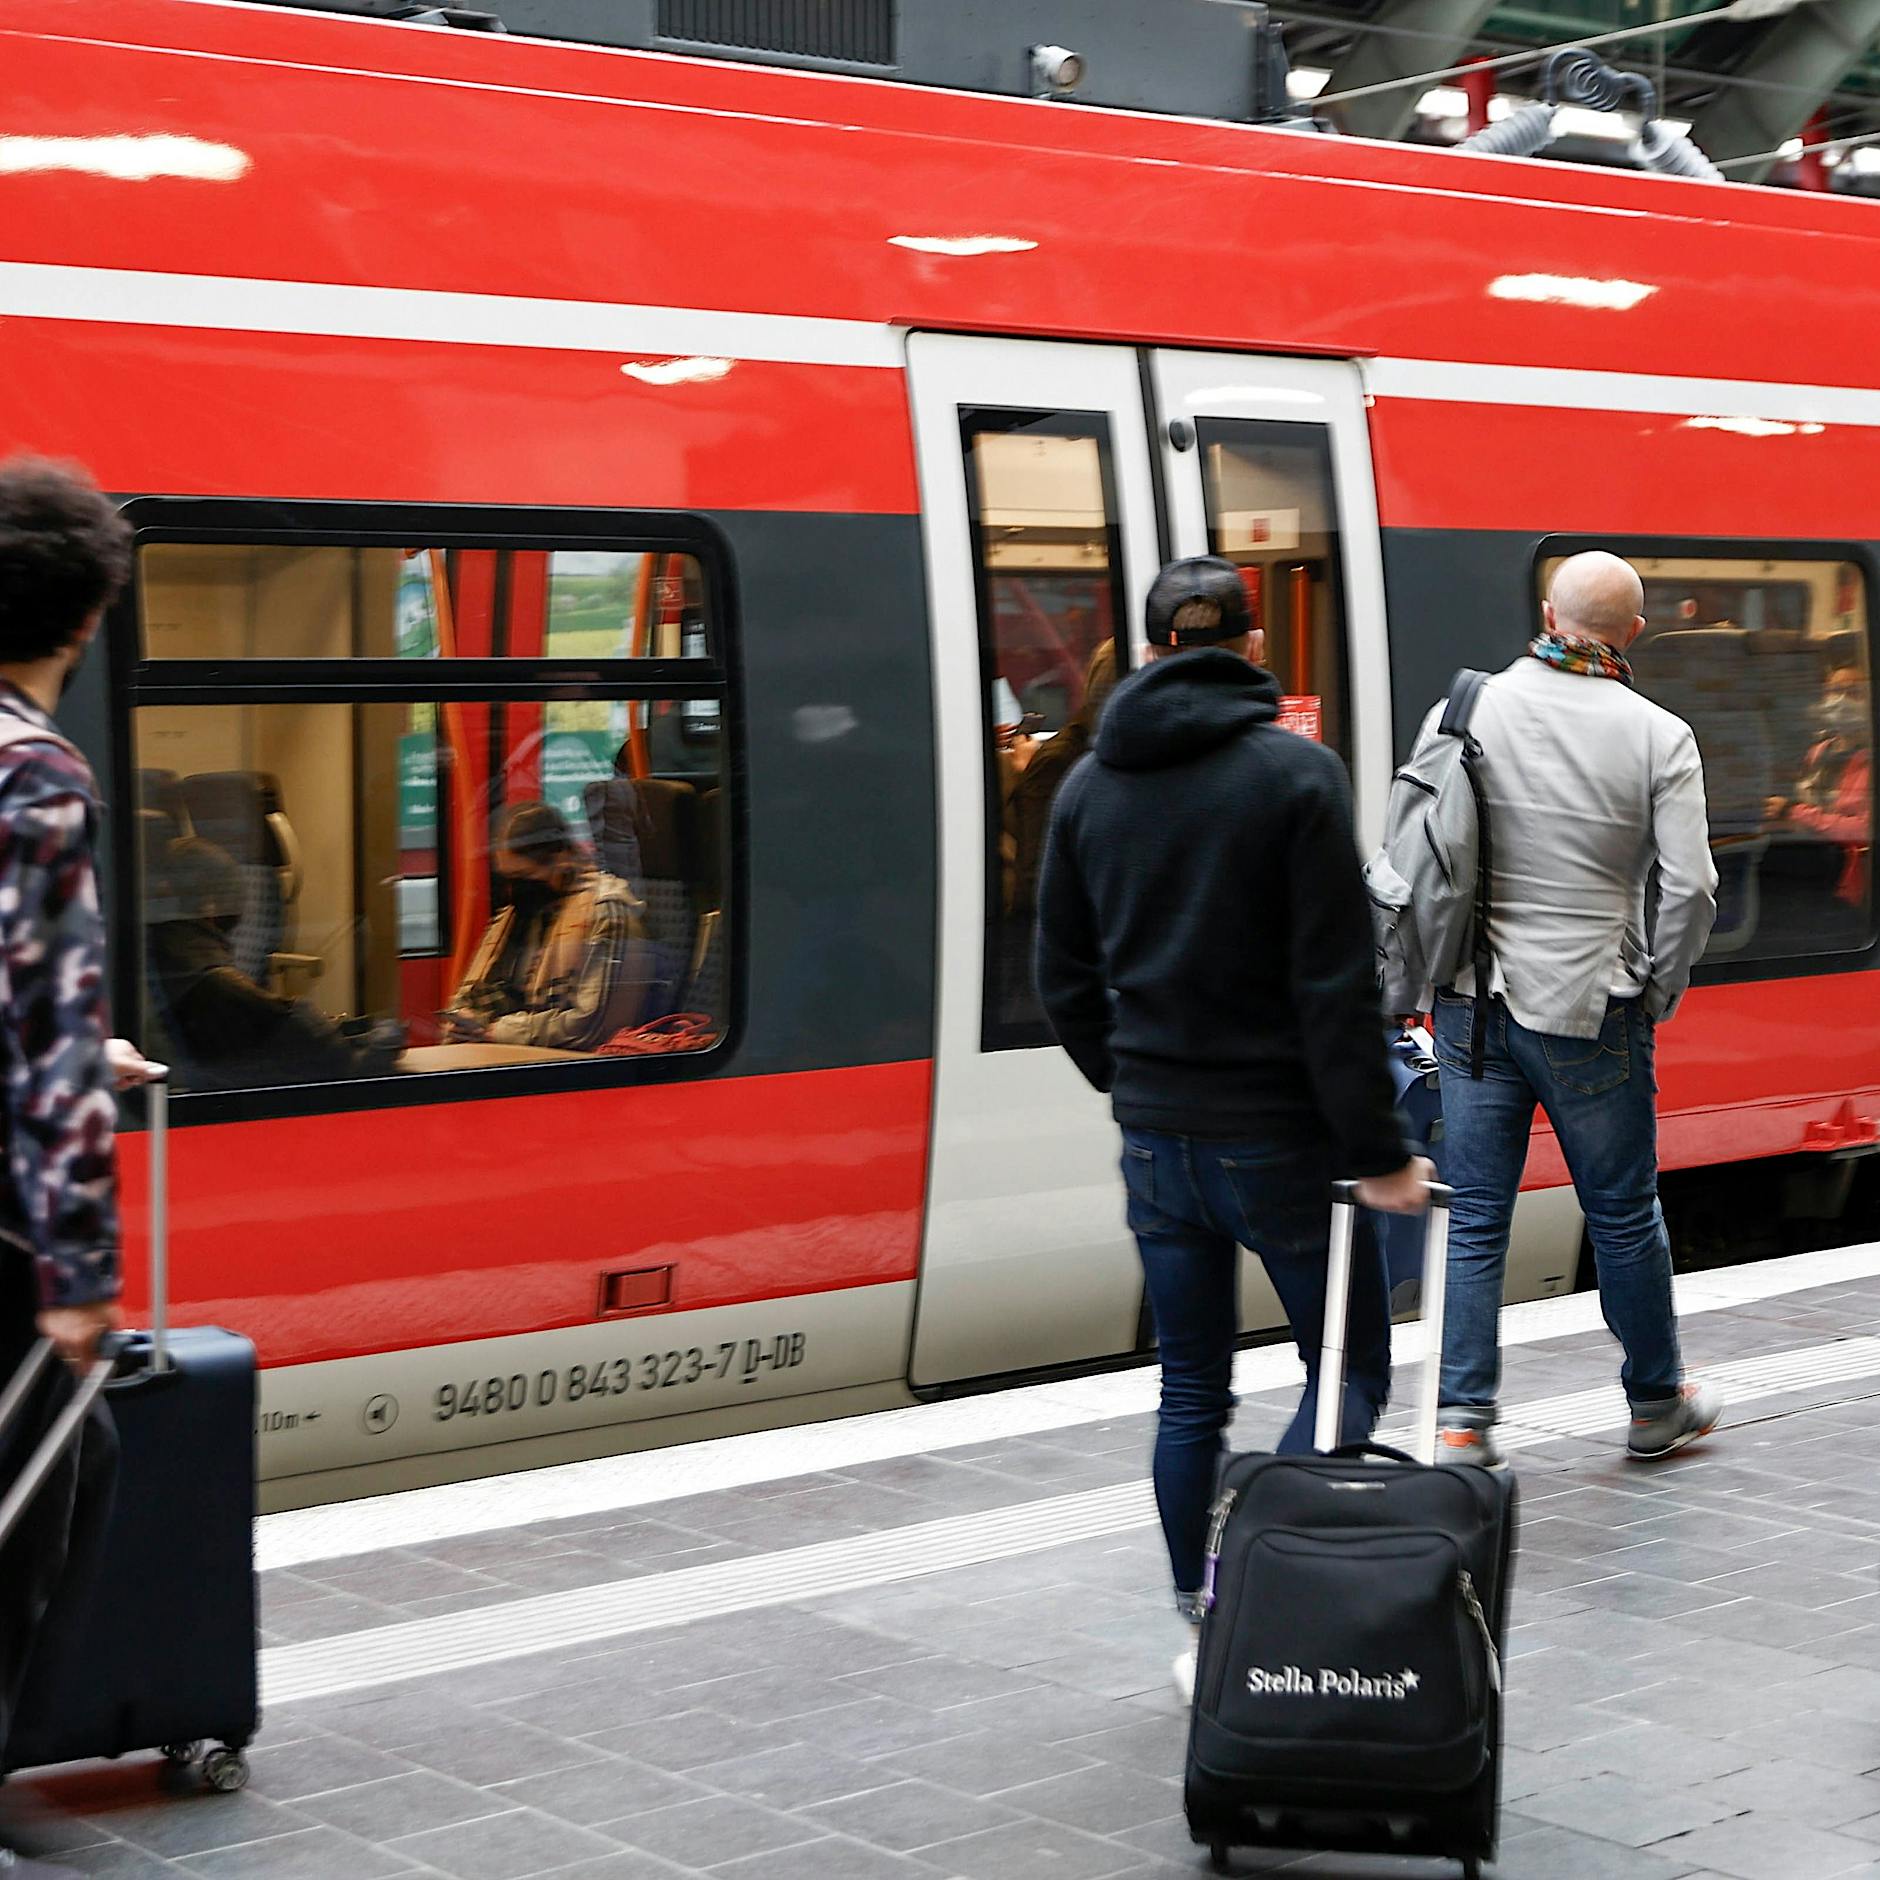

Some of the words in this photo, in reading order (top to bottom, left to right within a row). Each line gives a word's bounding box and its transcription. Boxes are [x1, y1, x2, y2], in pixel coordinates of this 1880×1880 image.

[567, 1357, 631, 1402] 843
[742, 1331, 806, 1385] D-DB
[1247, 1665, 1314, 1695] Stella
[1318, 1667, 1405, 1699] Polaris
